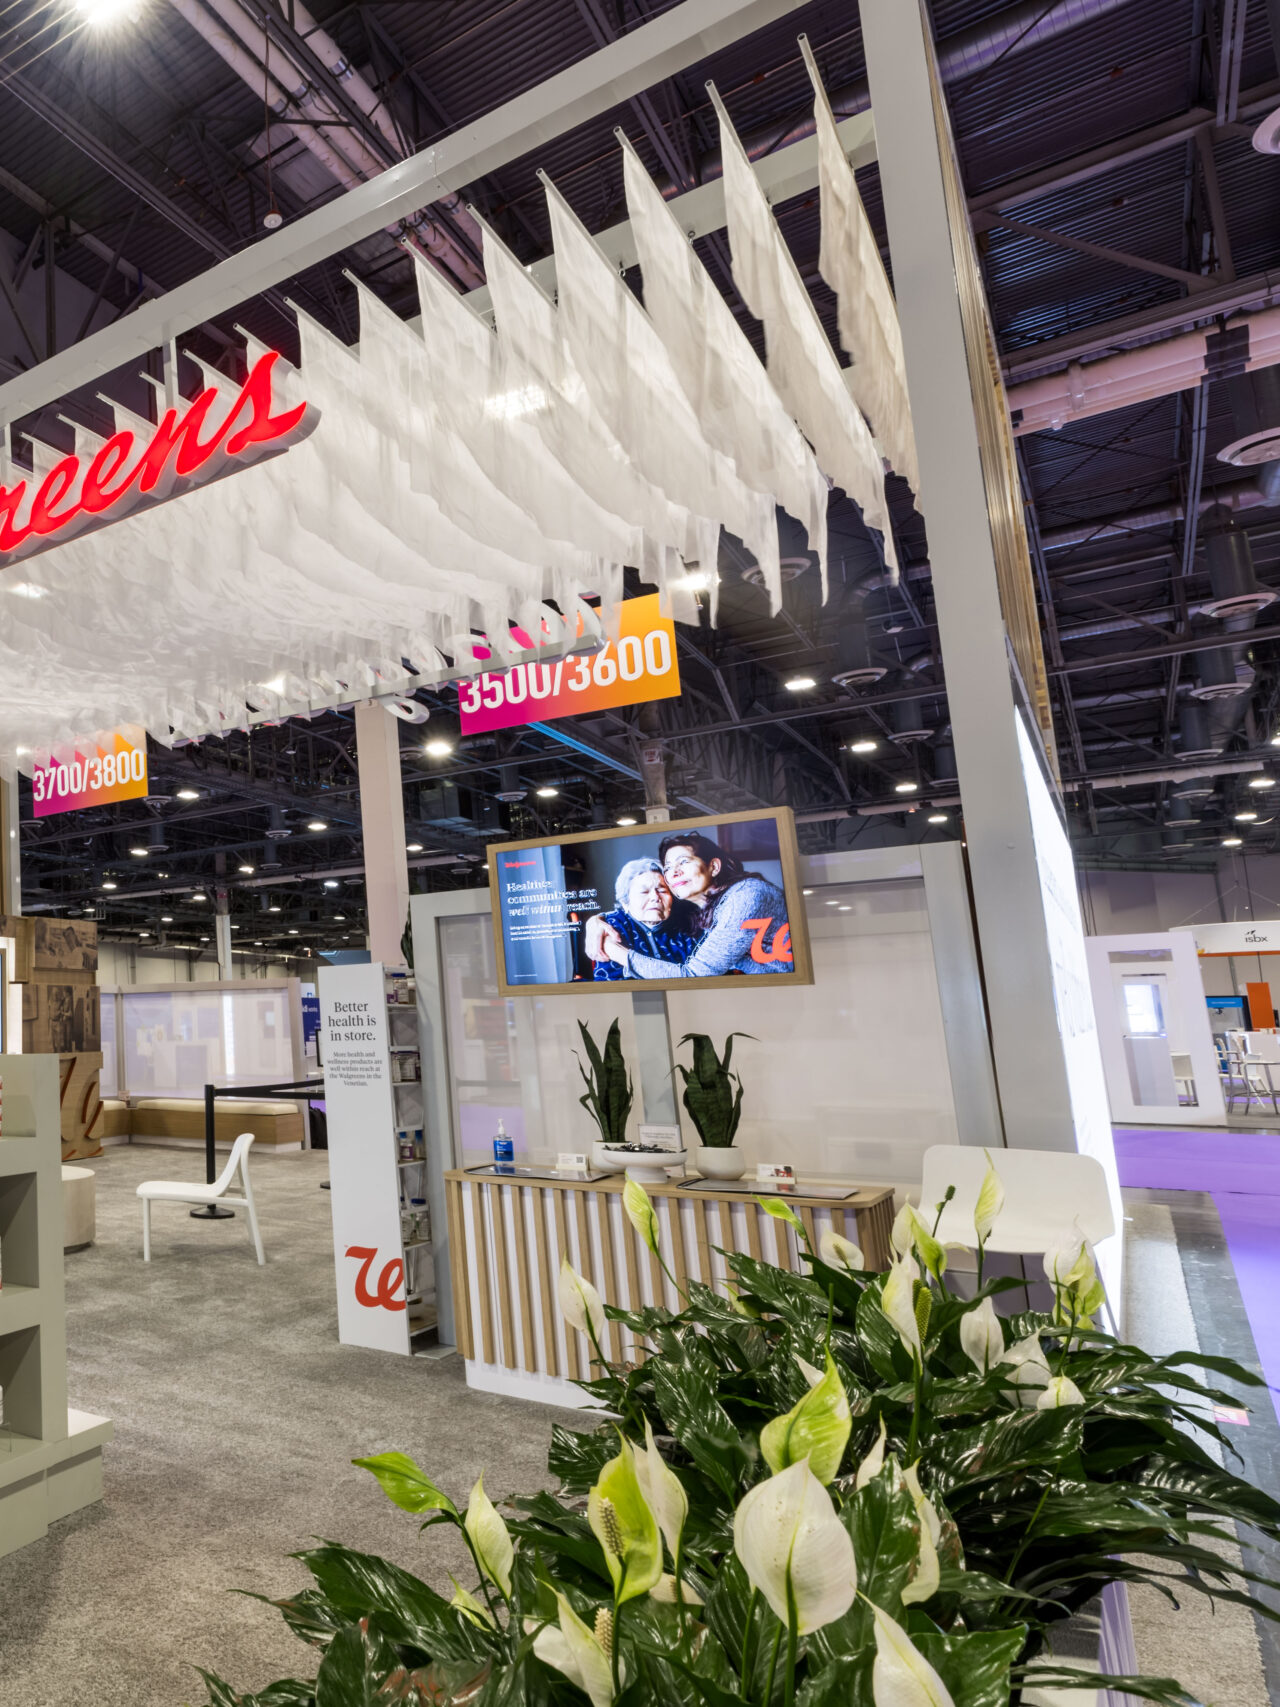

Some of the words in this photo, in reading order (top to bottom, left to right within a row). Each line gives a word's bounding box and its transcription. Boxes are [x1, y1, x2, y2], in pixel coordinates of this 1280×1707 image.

[459, 630, 672, 713] 3500/3600
[33, 748, 145, 801] 3700/3800
[1245, 931, 1268, 943] isbx
[334, 1001, 368, 1013] Better
[328, 1015, 364, 1027] health
[367, 1015, 377, 1026] is
[330, 1030, 342, 1041] in
[344, 1031, 376, 1041] store.
